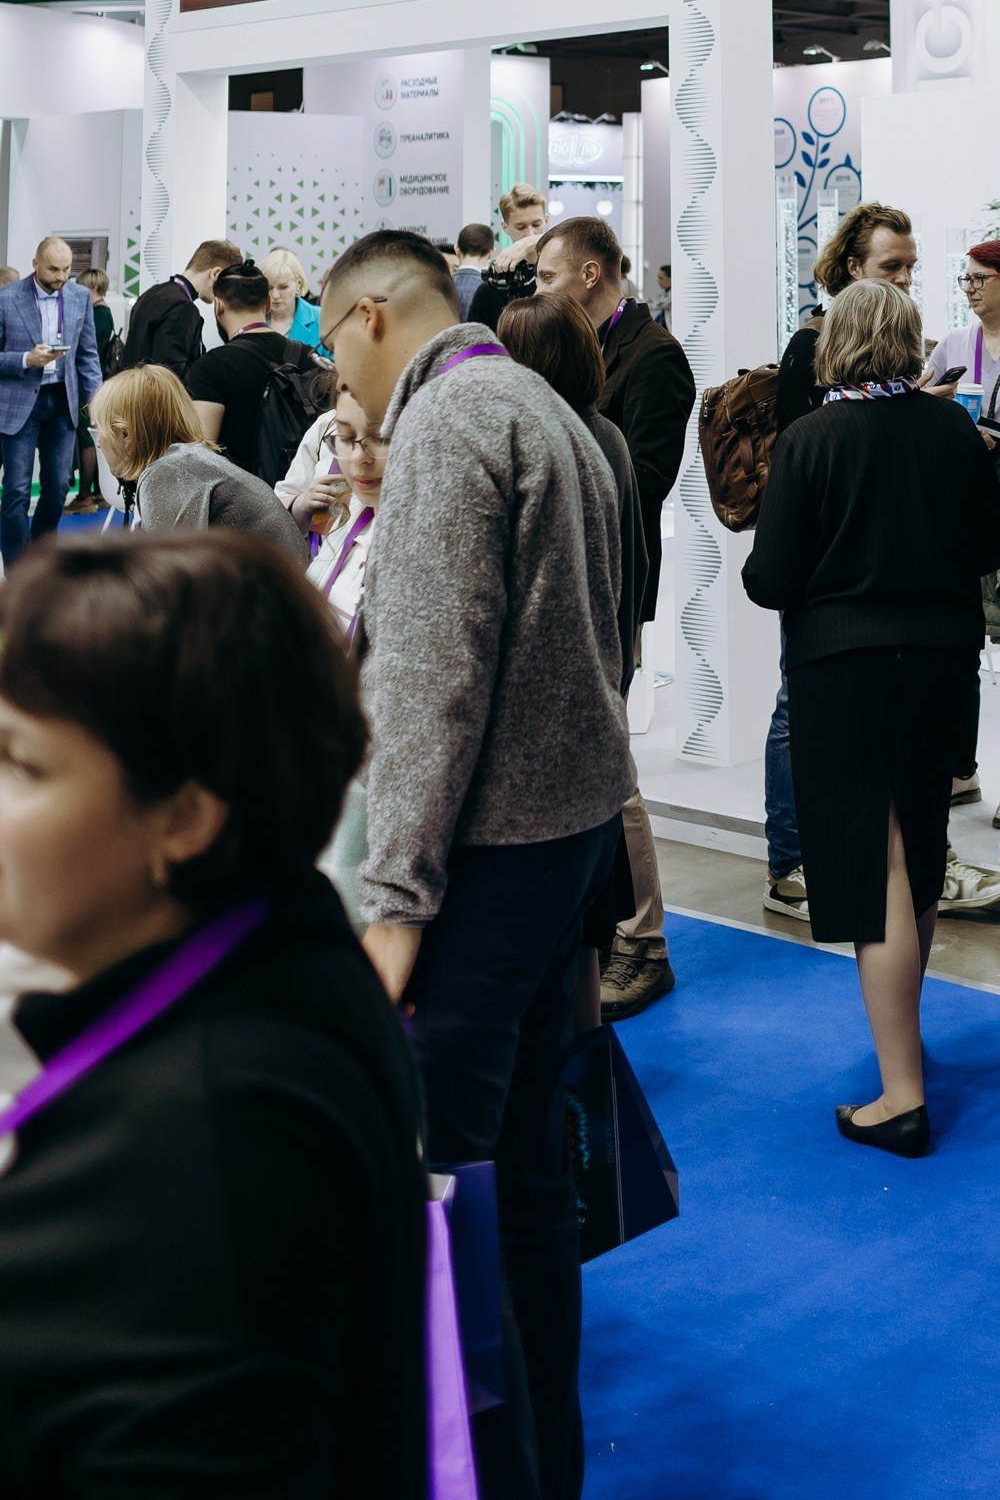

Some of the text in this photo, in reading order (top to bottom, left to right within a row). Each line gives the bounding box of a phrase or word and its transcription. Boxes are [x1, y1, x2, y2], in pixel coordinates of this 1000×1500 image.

[400, 76, 438, 87] РАСХОДНЫЕ
[400, 88, 439, 99] МАТЕРИАЛЫ
[400, 131, 450, 143] ПРЕАНАЛИТИКА
[399, 173, 448, 185] МЕДИЦИНСКОЕ
[399, 185, 450, 196] ОБОРУДОВАНИЕ
